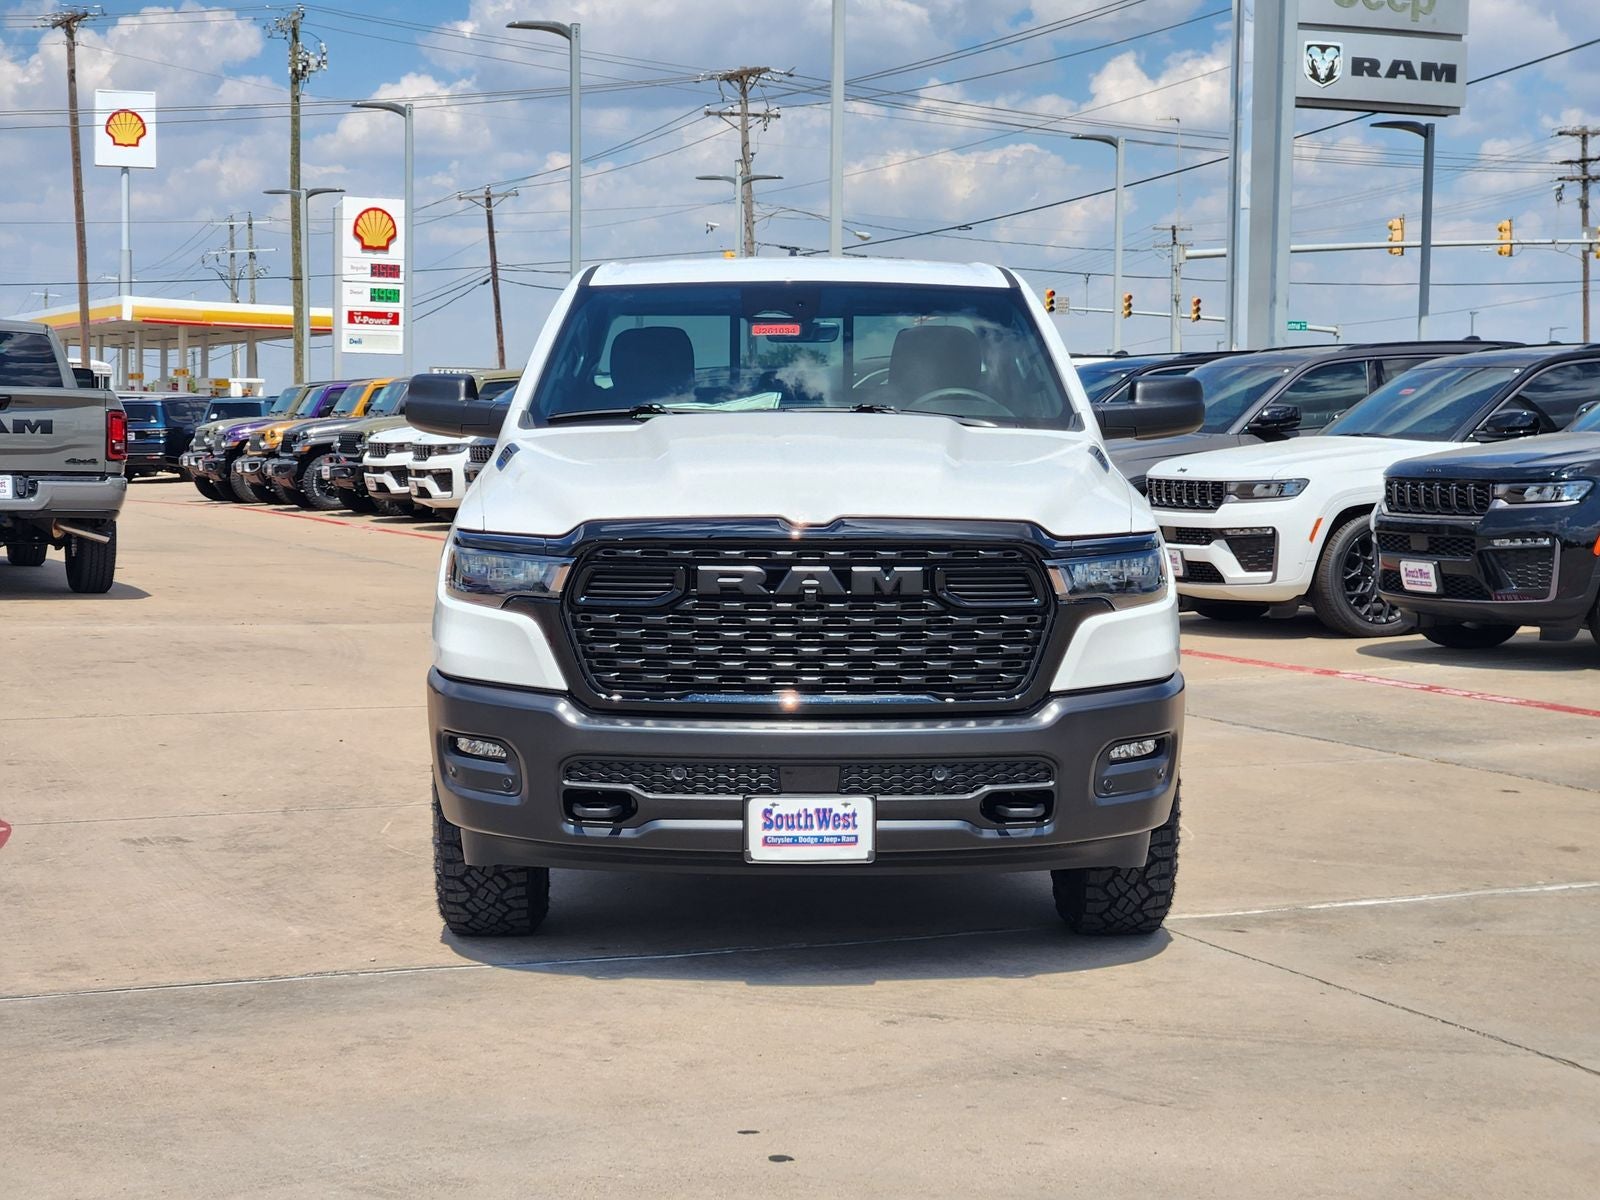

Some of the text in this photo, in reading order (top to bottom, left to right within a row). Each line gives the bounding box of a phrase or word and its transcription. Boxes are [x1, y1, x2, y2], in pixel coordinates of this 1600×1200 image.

[1351, 56, 1457, 83] RAM
[353, 316, 392, 325] V-Power
[697, 565, 924, 595] RAM
[766, 835, 856, 844] Chrysler Dodge Jeep Ram
